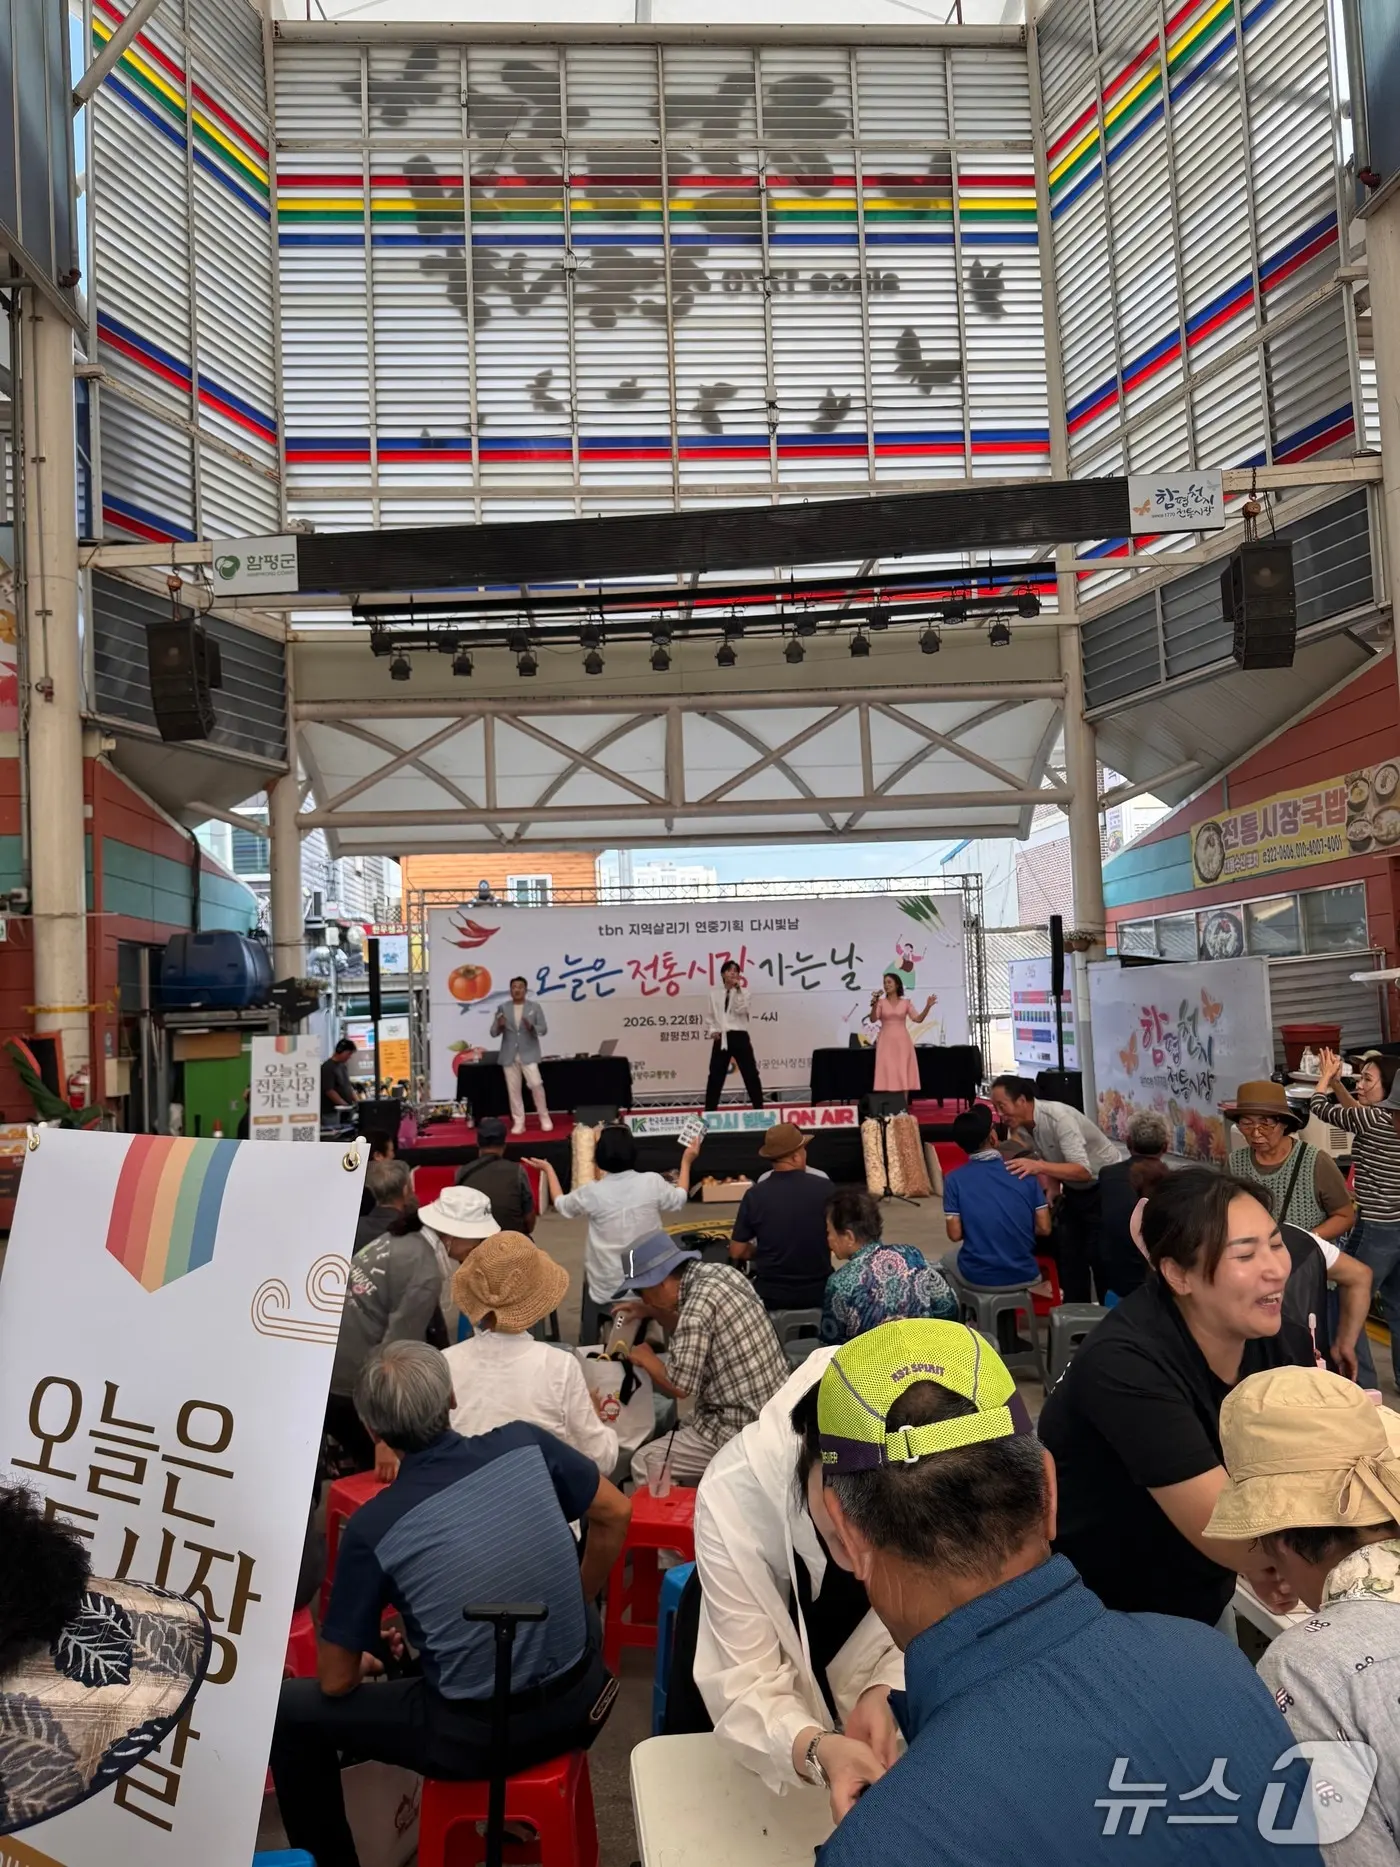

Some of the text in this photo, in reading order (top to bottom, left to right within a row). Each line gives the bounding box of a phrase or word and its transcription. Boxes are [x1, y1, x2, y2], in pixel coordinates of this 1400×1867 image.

[1154, 484, 1215, 511] 함평천지
[1176, 506, 1215, 518] 전통시장
[246, 553, 296, 571] 함평군
[1221, 785, 1349, 850] 전통시장국밥
[598, 918, 800, 937] tbn 지역살리기 연중기획 다시빛남
[536, 942, 864, 1001] 오늘은 전통시장 가는 날
[660, 1030, 700, 1042] 함평천지
[1140, 999, 1213, 1067] 함평천지
[264, 1062, 309, 1078] 오늘은
[256, 1077, 316, 1094] 전통시장
[1166, 1066, 1215, 1102] 전통시장
[261, 1092, 310, 1109] 가는 날
[787, 1108, 854, 1126] ON AIR
[910, 1362, 946, 1378] SPIRIT
[10, 1375, 235, 1528] 오늘은
